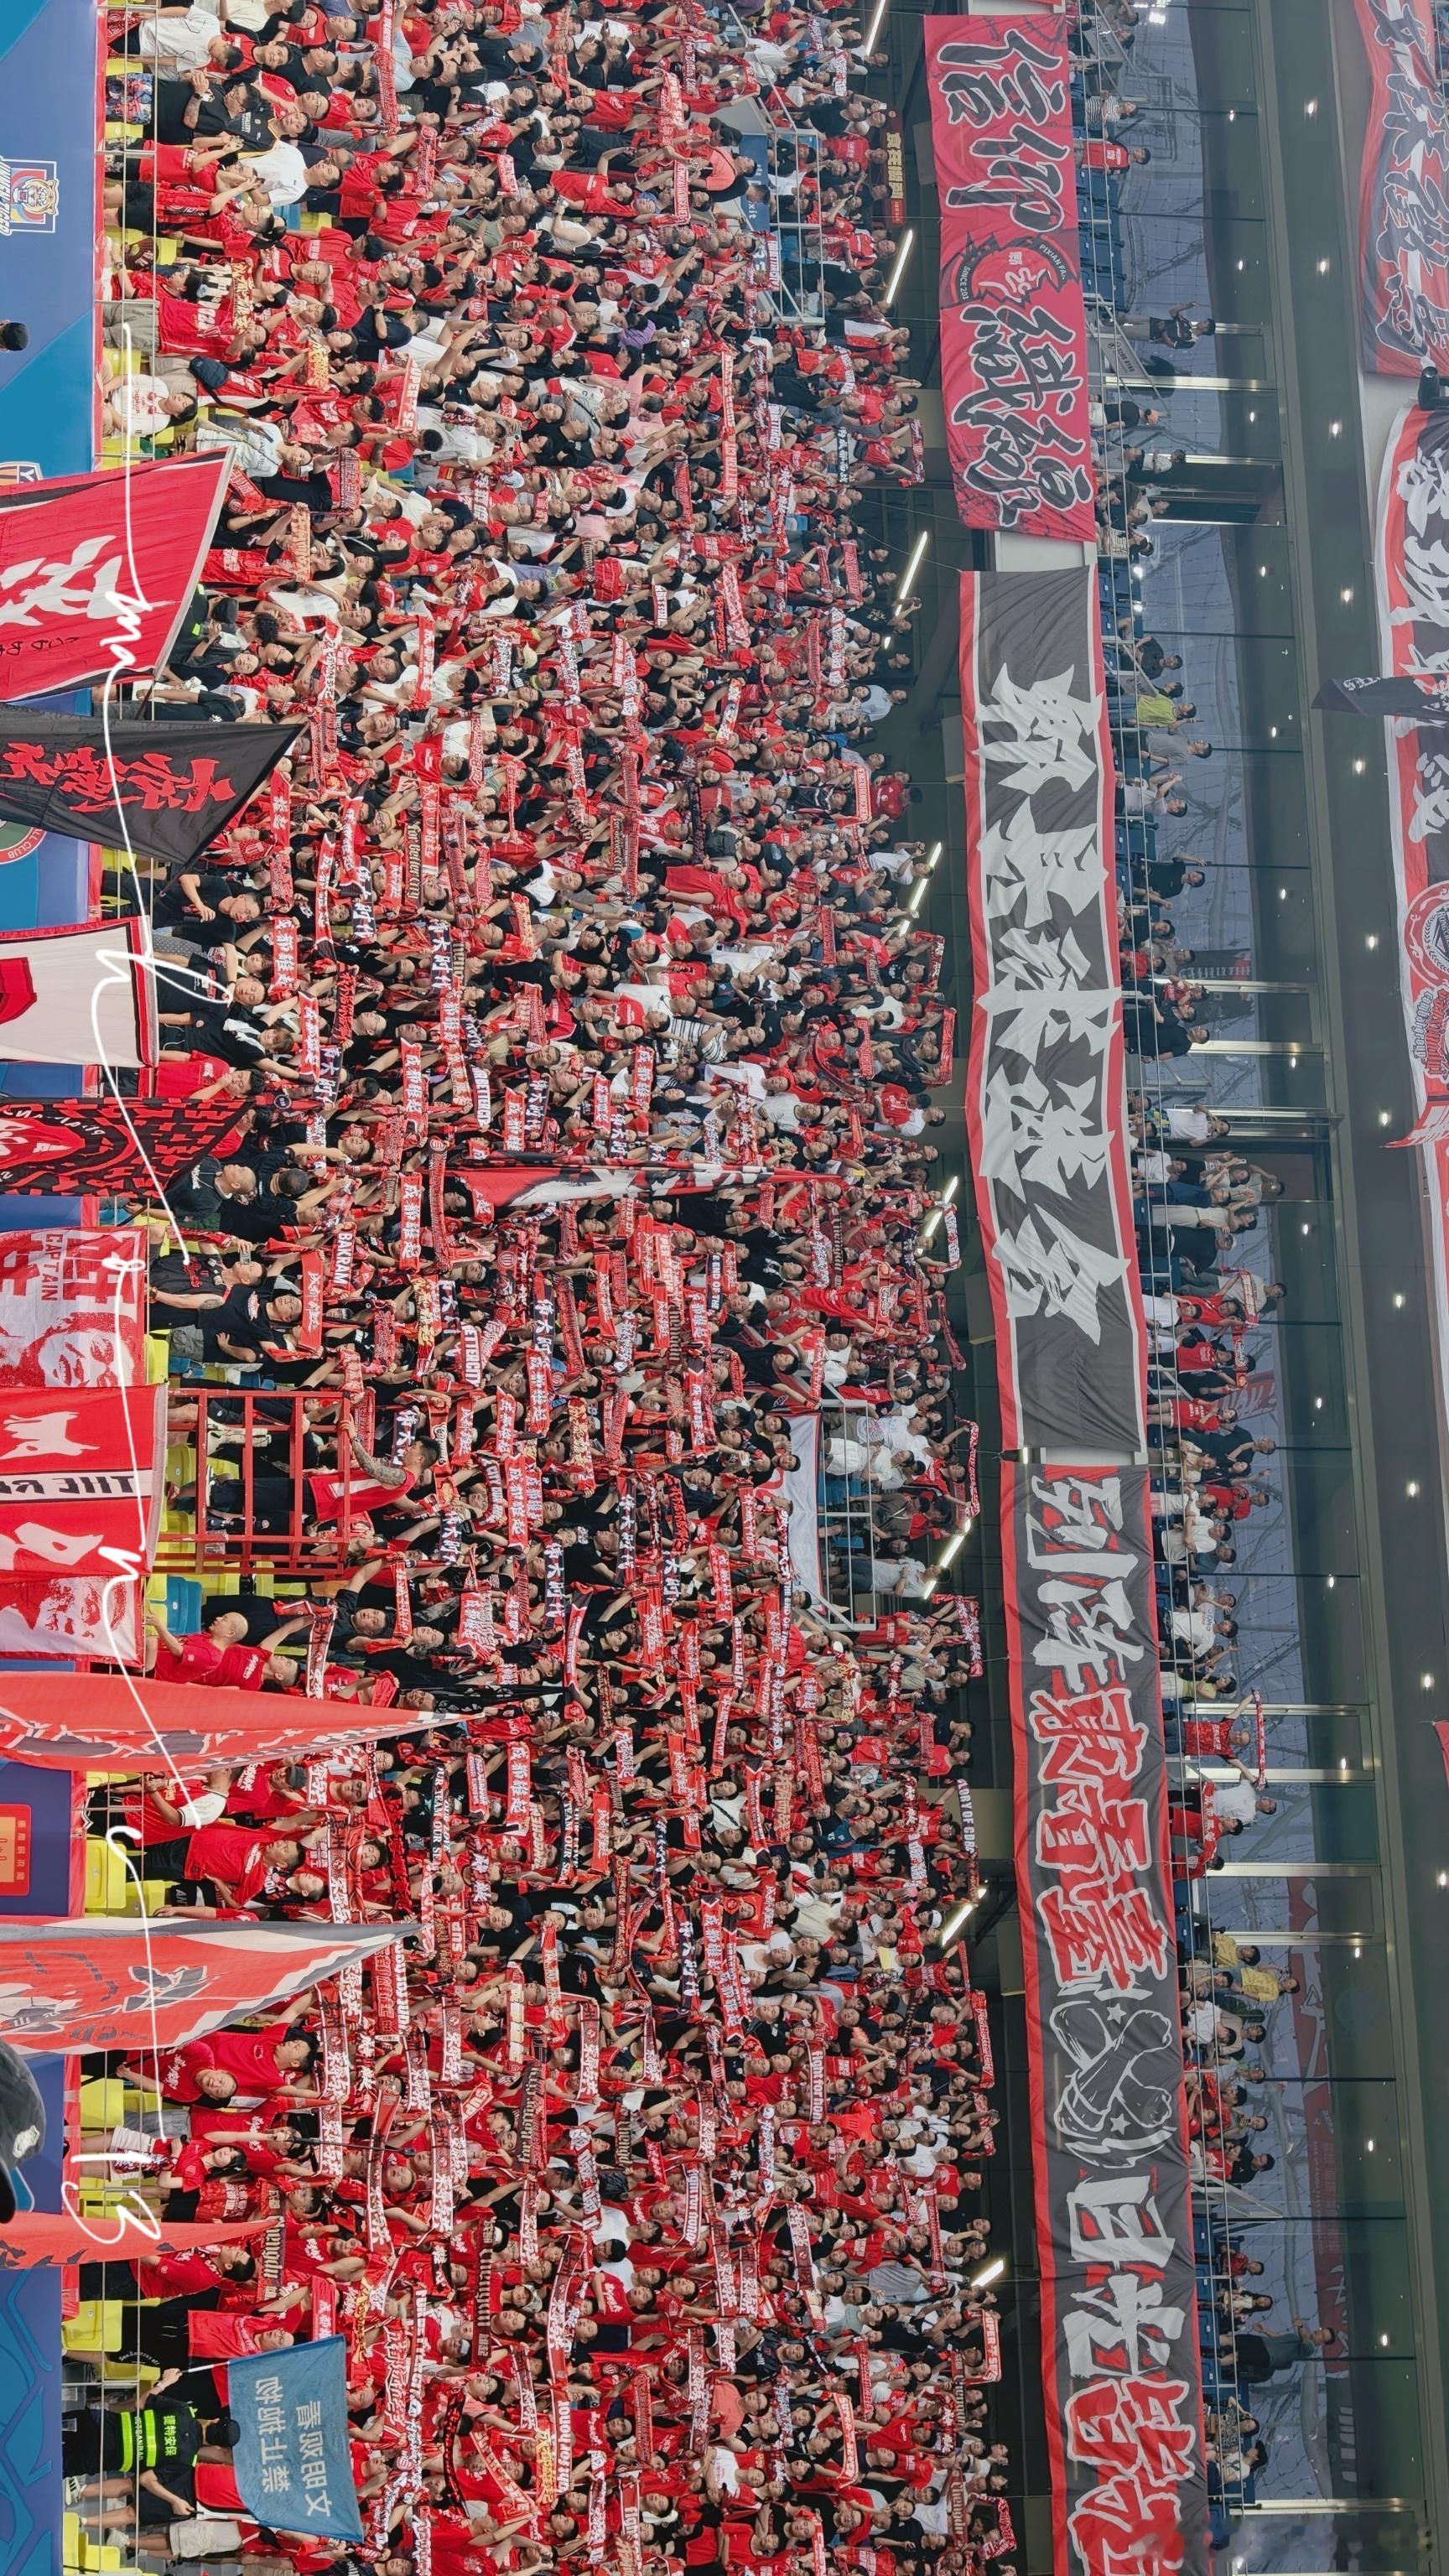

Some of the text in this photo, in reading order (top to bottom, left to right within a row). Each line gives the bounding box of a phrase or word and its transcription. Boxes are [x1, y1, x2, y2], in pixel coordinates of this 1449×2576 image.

[960, 266, 971, 300] SINCE 201
[1039, 244, 1067, 280] PIXIAN FA
[7, 842, 32, 858] CLUB
[409, 843, 418, 875] Better
[353, 866, 374, 938] 伟大时代
[428, 919, 452, 989] 伟大时代
[304, 1006, 319, 1063] 成都雄起
[406, 1053, 422, 1113] 成都雄起
[525, 1079, 549, 1130] 伟大时代
[504, 1101, 523, 1152] 成都雄
[610, 1114, 628, 1158] 伟大时
[402, 1182, 419, 1259] 成都雄起
[40, 1233, 65, 1301] CAPTAIN
[333, 1233, 353, 1284] BAKRAM
[712, 1262, 720, 1279] END
[712, 1294, 720, 1310] THE
[528, 1356, 549, 1423] 成都雄起
[509, 1467, 526, 1535] 成都雄起
[618, 1493, 635, 1569] 伟大时代
[546, 1542, 564, 1618] 伟大时代
[782, 1617, 790, 1629] OF
[783, 1597, 792, 1615] END
[434, 1789, 444, 1816] TEAM
[511, 1745, 527, 1814] 成都雄起
[434, 1820, 443, 1841] OUR
[563, 1802, 573, 1831] TEAM
[963, 1810, 974, 1824] OF
[563, 1835, 573, 1858] OUR
[679, 1921, 700, 1997] 伟大时代
[705, 1914, 721, 1971] 成都雄起
[444, 2032, 460, 2082] 荣辱与共
[582, 2044, 598, 2096] 荣辱与共
[810, 2050, 824, 2077] fight
[411, 2068, 429, 2111] 荣辱与共
[813, 2079, 824, 2096] for
[324, 2119, 341, 2175] 荣辱与共
[369, 2186, 391, 2245] 荣辱与共
[434, 2174, 452, 2231] 荣辱与共
[262, 2215, 284, 2280] Chengdu
[717, 2264, 738, 2309] 荣辱与共
[741, 2277, 757, 2315] 荣辱与共
[318, 2299, 332, 2340] 成都雄
[548, 2298, 564, 2350] 荣辱与共
[719, 2326, 736, 2370] 荣辱与共
[163, 2415, 177, 2456] 捷特安保
